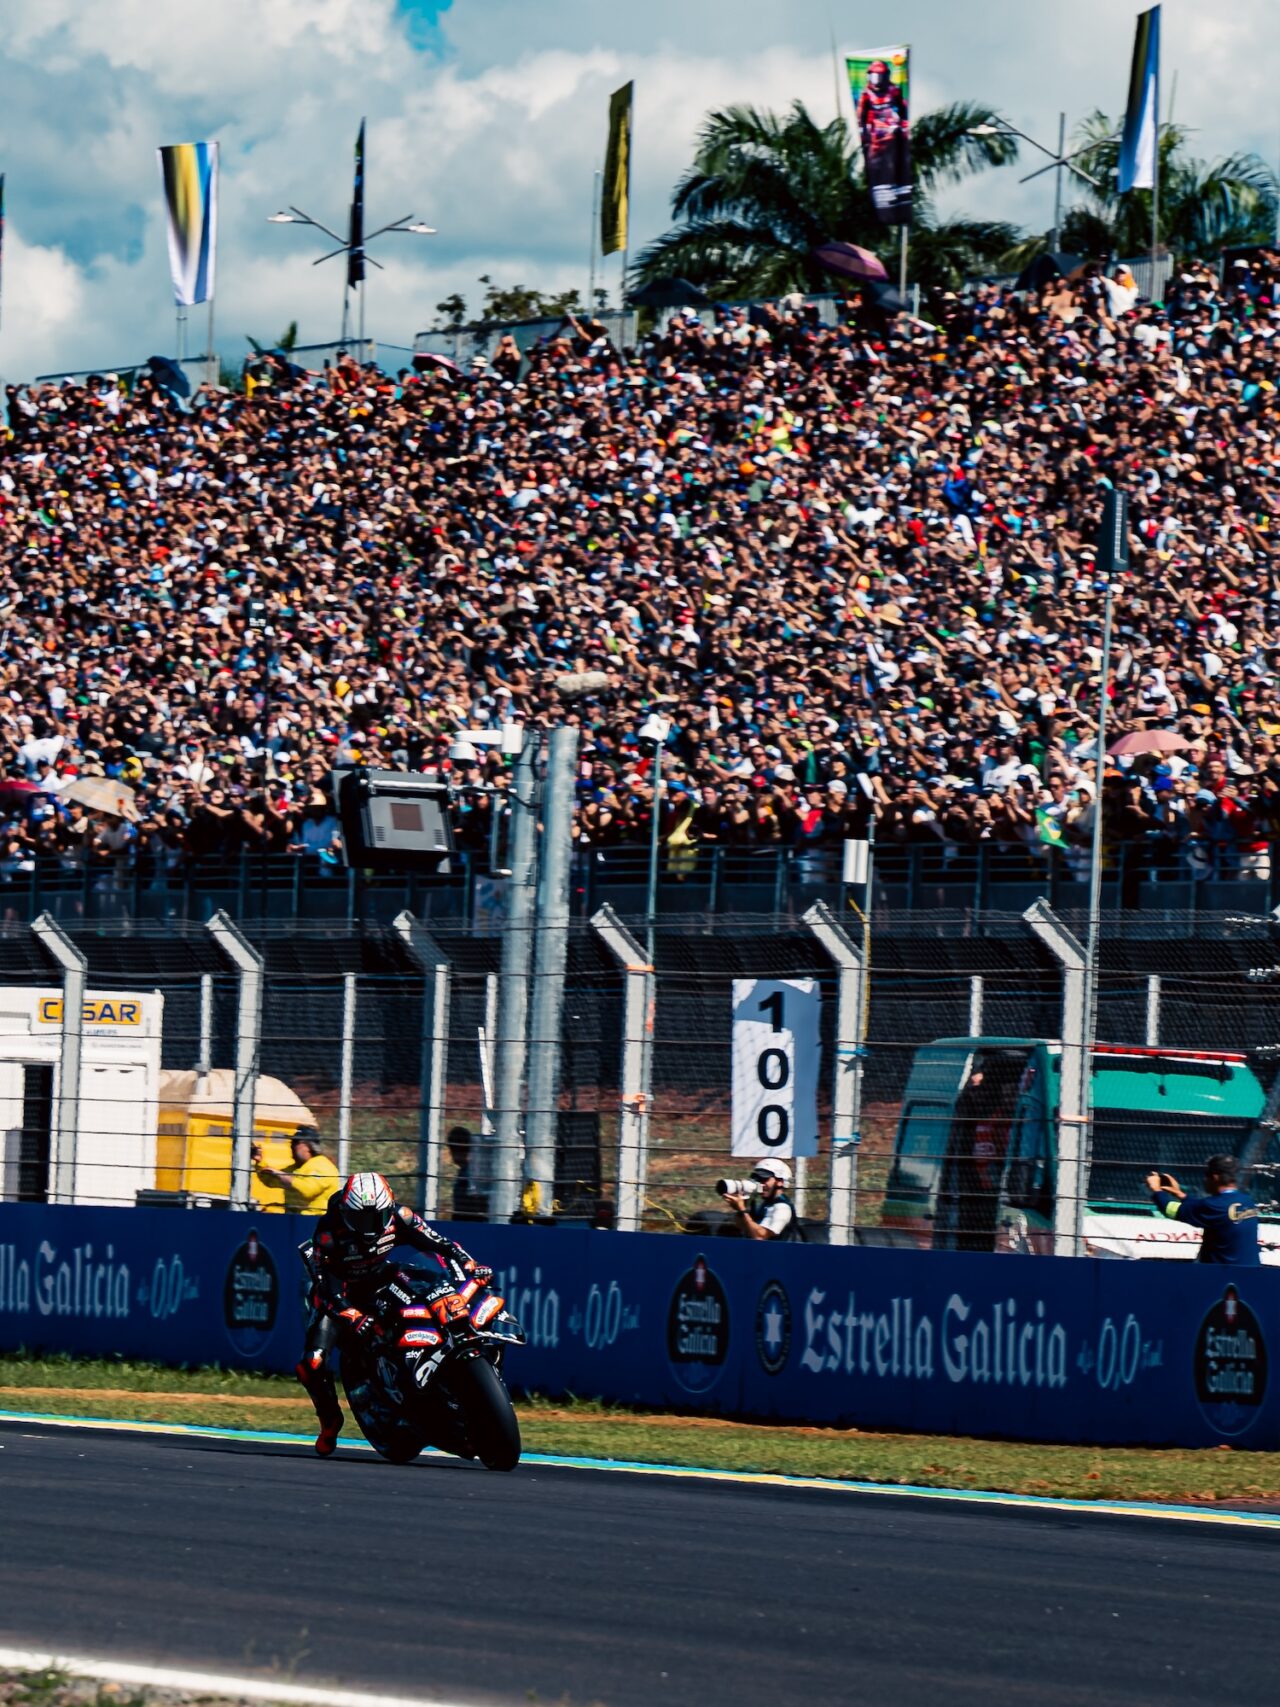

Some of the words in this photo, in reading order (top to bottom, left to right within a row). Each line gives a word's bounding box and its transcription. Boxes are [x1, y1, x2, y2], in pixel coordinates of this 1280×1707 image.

[43, 1002, 136, 1022] CSAR
[758, 991, 789, 1147] 100
[35, 1240, 130, 1318] Galicia
[497, 1265, 560, 1348] licia
[800, 1287, 935, 1380] Estrella
[942, 1293, 1067, 1388] Galicia
